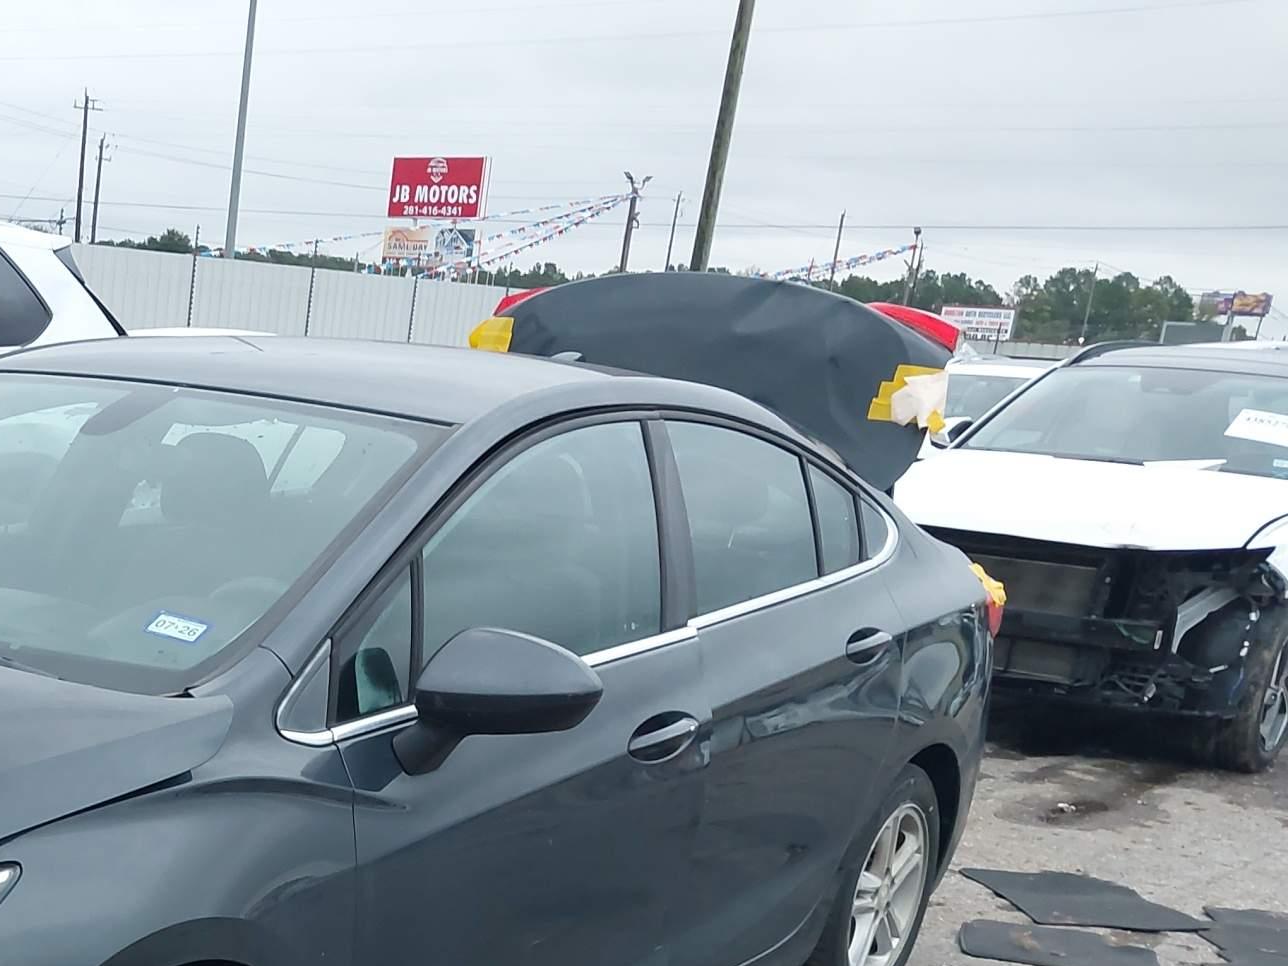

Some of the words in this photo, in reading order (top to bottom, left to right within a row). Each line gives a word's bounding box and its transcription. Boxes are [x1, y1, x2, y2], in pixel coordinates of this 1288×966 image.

[392, 184, 410, 203] JB
[414, 184, 478, 204] MOTORS
[402, 205, 463, 216] 281-416-4341
